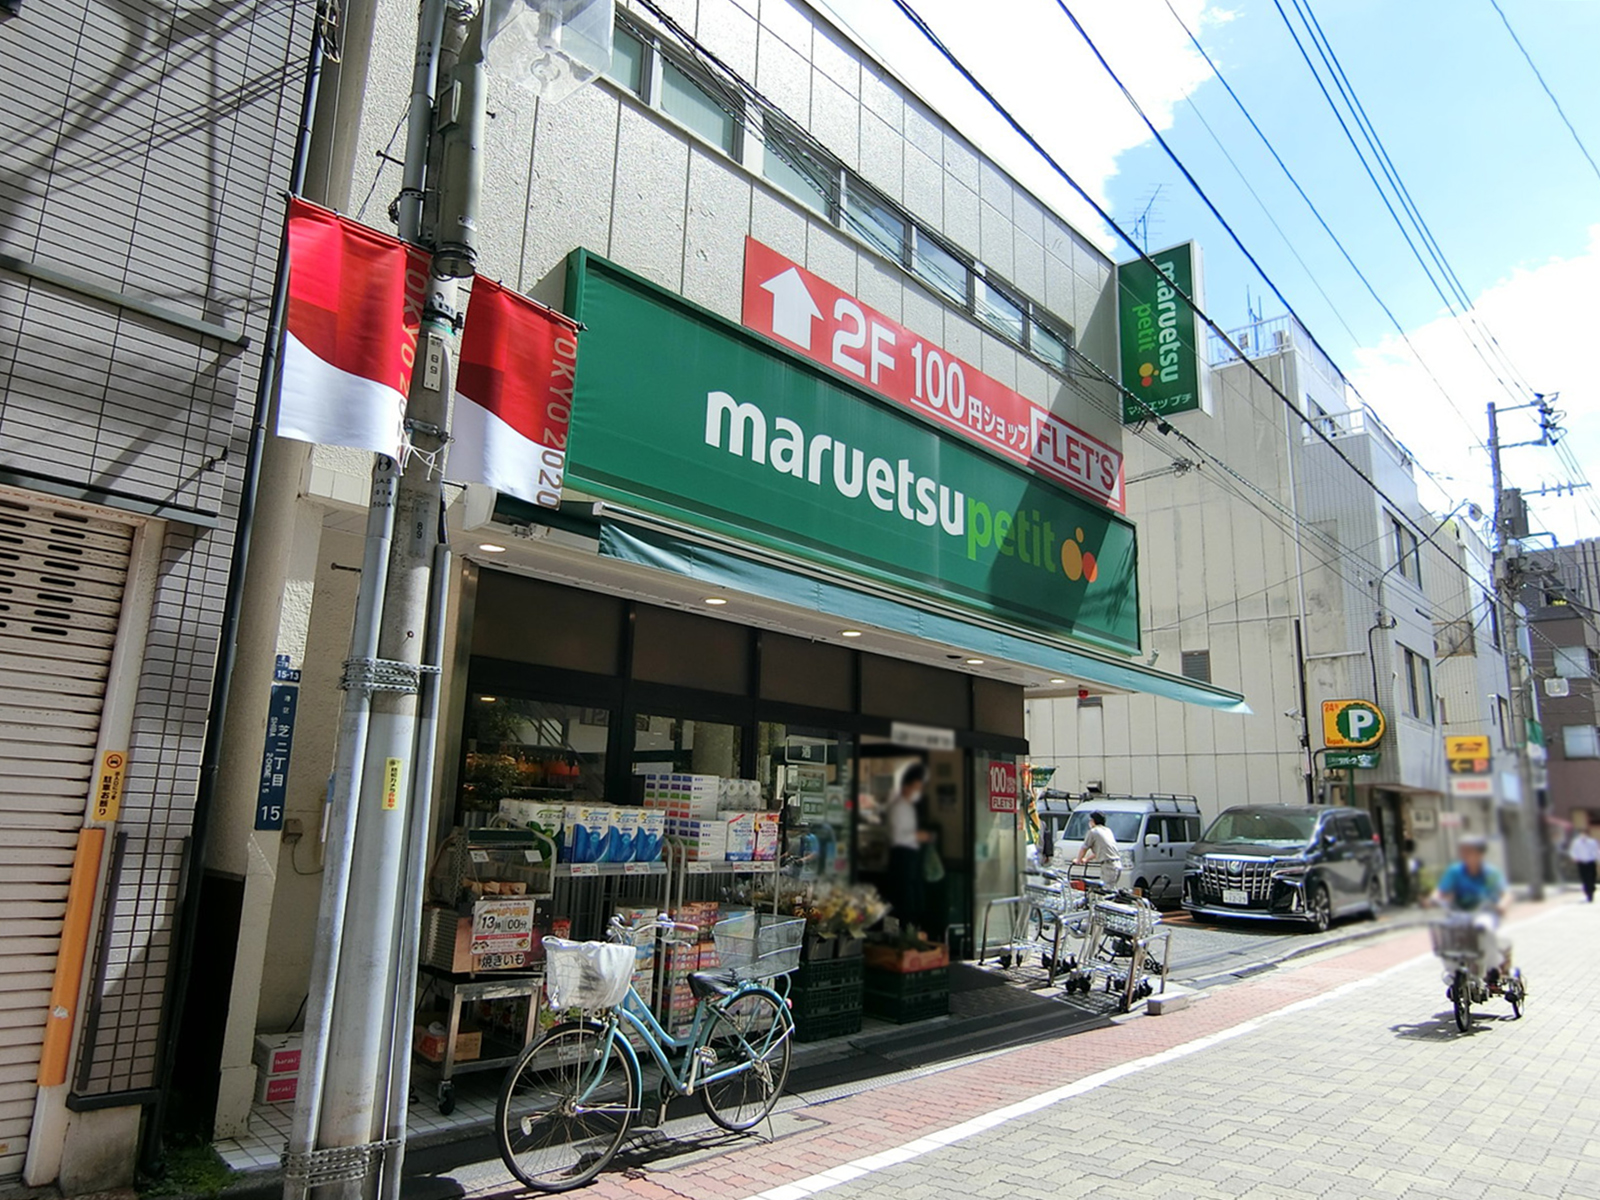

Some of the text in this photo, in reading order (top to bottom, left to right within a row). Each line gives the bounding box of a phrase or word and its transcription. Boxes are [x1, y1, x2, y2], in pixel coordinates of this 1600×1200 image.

[1132, 303, 1156, 353] petit
[1156, 260, 1181, 383] maruetsu
[831, 297, 1029, 451] 2F 100円ショップ
[536, 427, 567, 511] 2020
[704, 390, 1057, 573] maruetsu petit
[1037, 425, 1115, 491] FLET'S
[277, 669, 300, 681] 15-13
[1348, 709, 1374, 738] P
[272, 724, 291, 787] 芝二丁目
[990, 766, 1007, 793] 100
[261, 805, 281, 821] 15
[481, 953, 525, 969] 焼きいも
